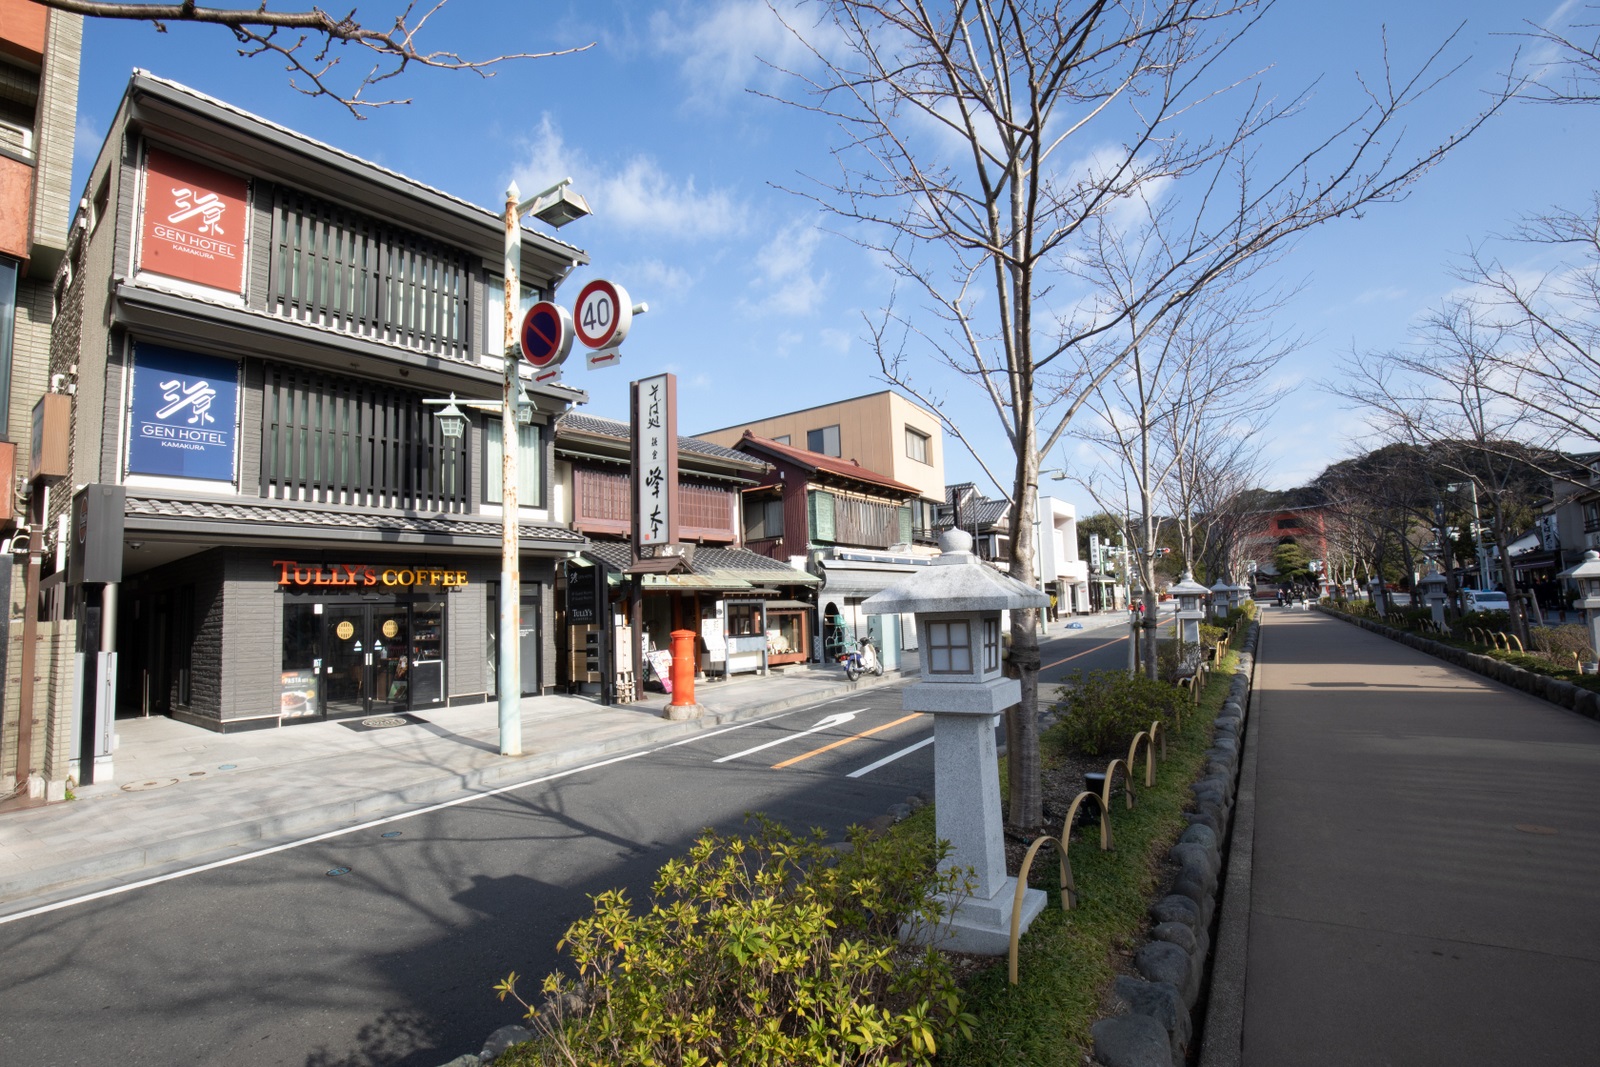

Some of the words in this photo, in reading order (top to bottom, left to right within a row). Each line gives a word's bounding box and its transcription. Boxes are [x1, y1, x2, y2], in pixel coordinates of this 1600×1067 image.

[154, 226, 185, 242] GEN
[189, 236, 234, 256] HOTEL
[172, 244, 214, 260] KAMAKURA
[582, 298, 610, 330] 40
[142, 425, 175, 438] GEN
[179, 429, 226, 444] HOTEL
[161, 441, 205, 451] KAMAKURA
[382, 569, 469, 586] COFFEE
